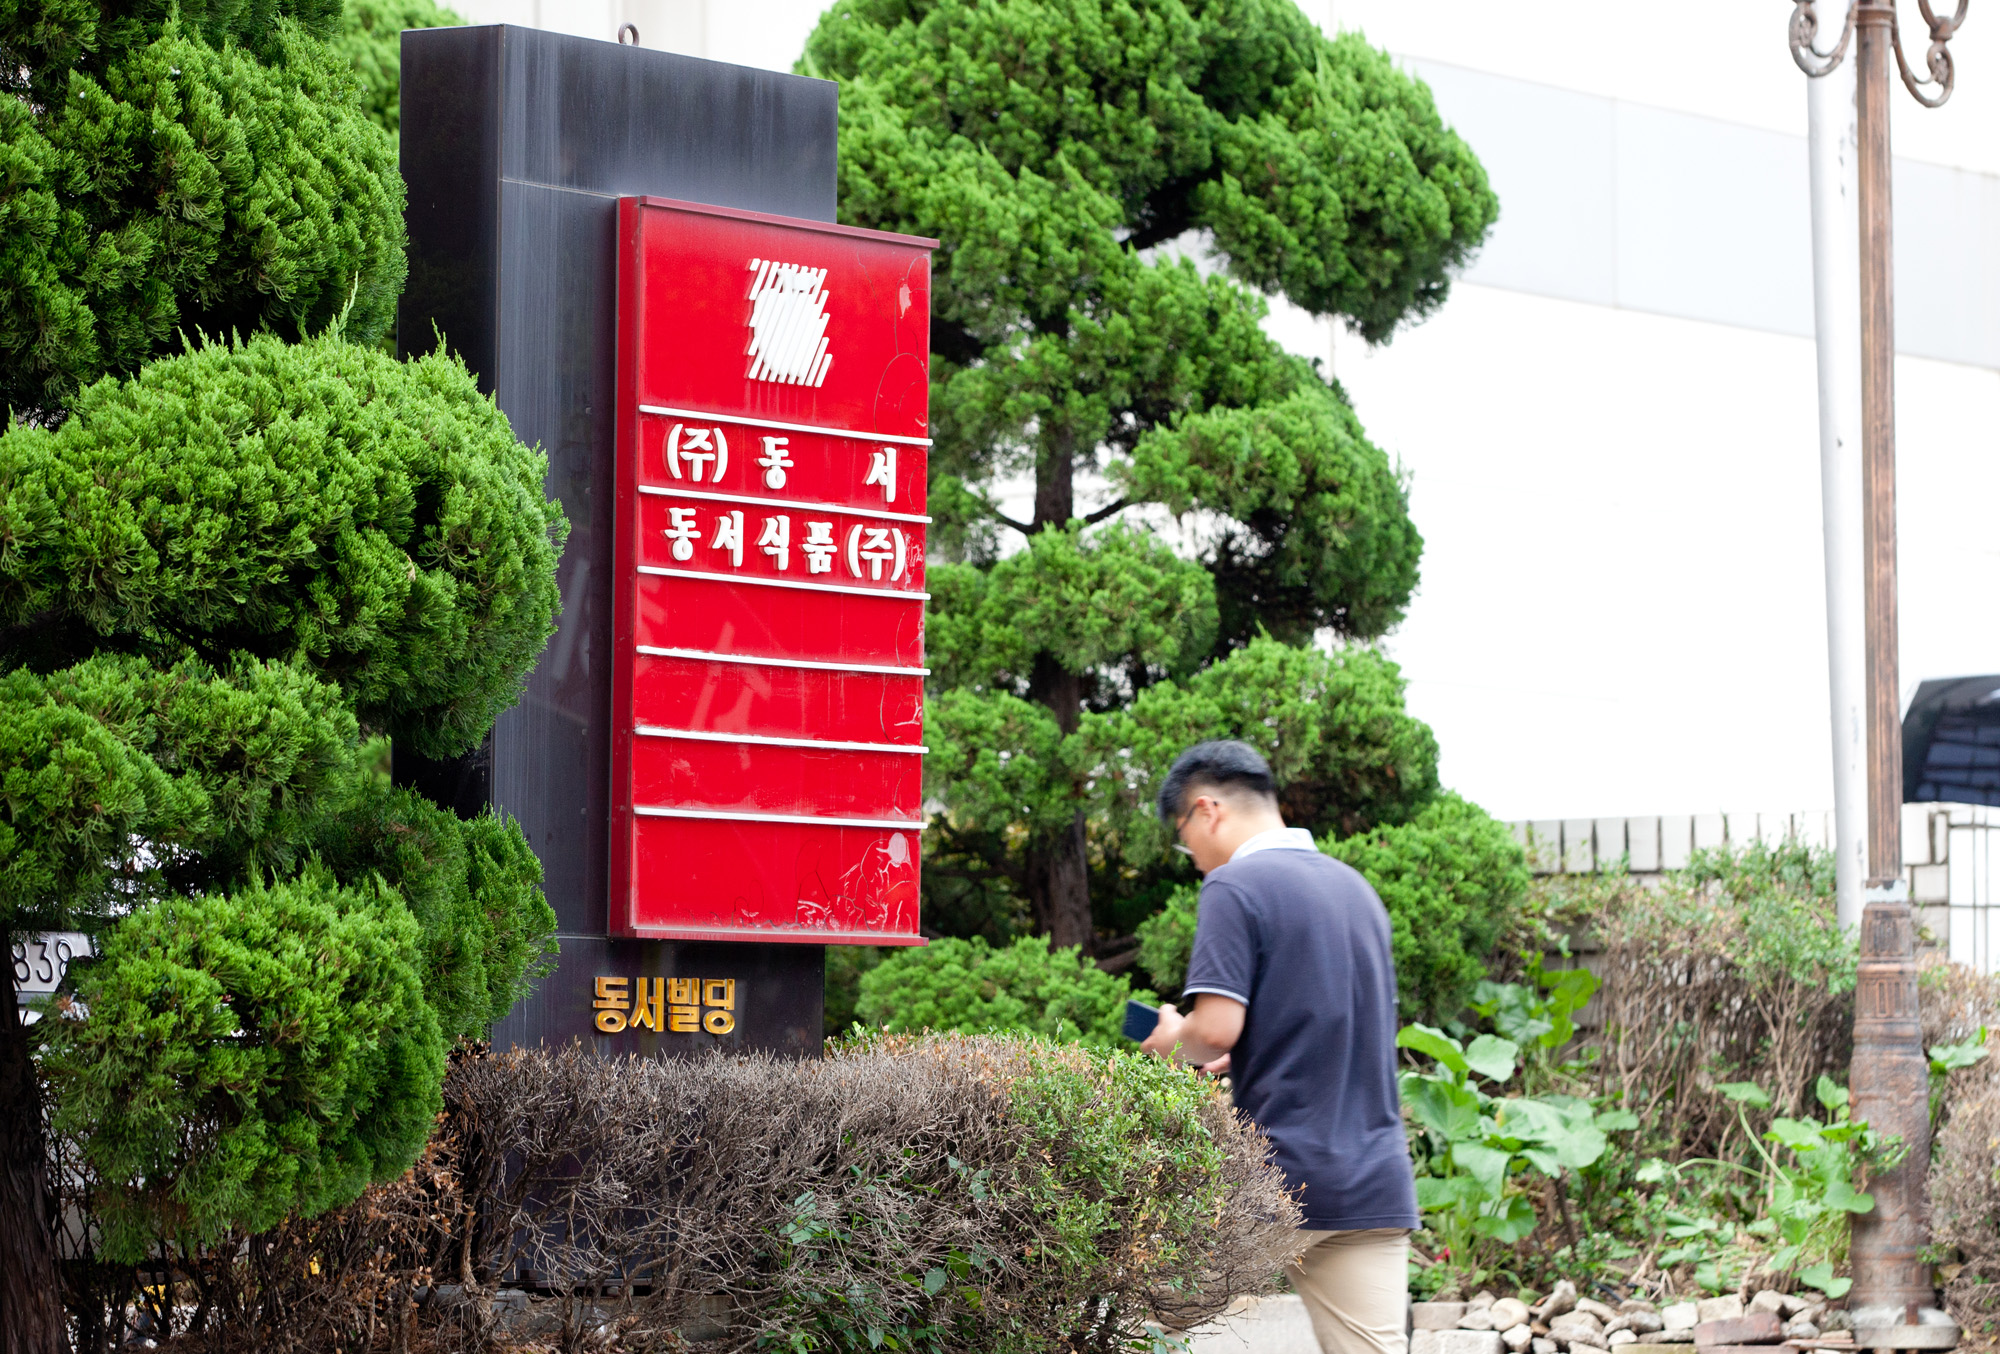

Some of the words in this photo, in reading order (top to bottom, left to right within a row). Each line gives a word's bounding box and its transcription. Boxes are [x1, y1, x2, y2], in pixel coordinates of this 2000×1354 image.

[666, 424, 728, 483] (주)
[664, 507, 906, 581] 동서식품(주)
[593, 977, 735, 1034] 동서빌딩
